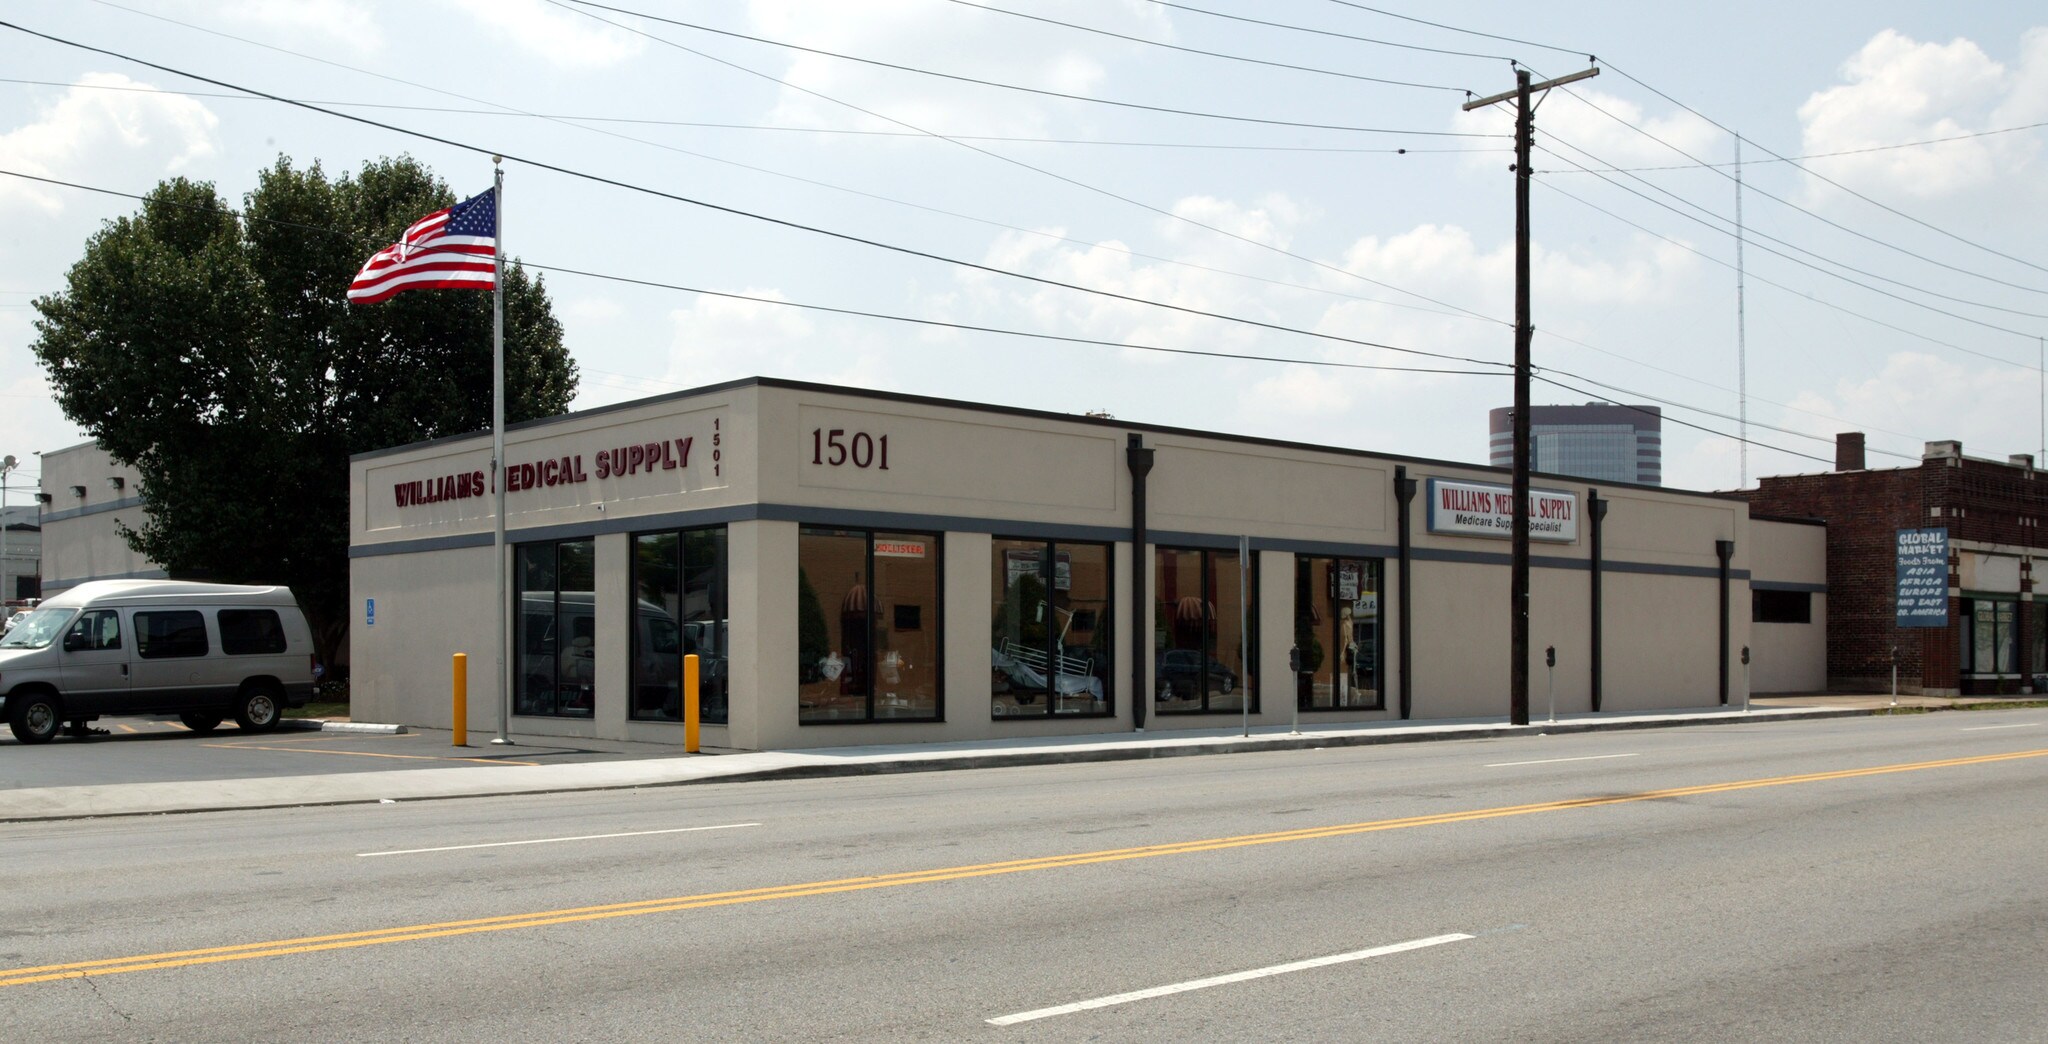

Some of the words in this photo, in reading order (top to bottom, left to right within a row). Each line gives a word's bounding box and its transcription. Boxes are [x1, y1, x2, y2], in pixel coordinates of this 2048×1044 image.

[713, 418, 721, 477] 1501
[812, 427, 889, 470] 1501
[394, 470, 485, 508] WILLIAMS
[595, 436, 694, 480] SUPPLY
[1441, 488, 1491, 514] WILLIAMS
[1494, 494, 1536, 518] MEDL
[1539, 498, 1572, 521] SUPPLY
[1455, 514, 1492, 527] Medicare
[1529, 520, 1562, 533] pecialist
[1899, 532, 1944, 545] GLOBAL
[1898, 544, 1944, 555] MARKET
[1898, 557, 1921, 566] Foods
[1922, 557, 1945, 566] From
[1906, 567, 1936, 576] ASIA
[1899, 578, 1942, 586] AFRICA
[1899, 588, 1943, 596] EUROPE
[1918, 598, 1943, 607] EAST
[1910, 608, 1947, 616] AMERICA
